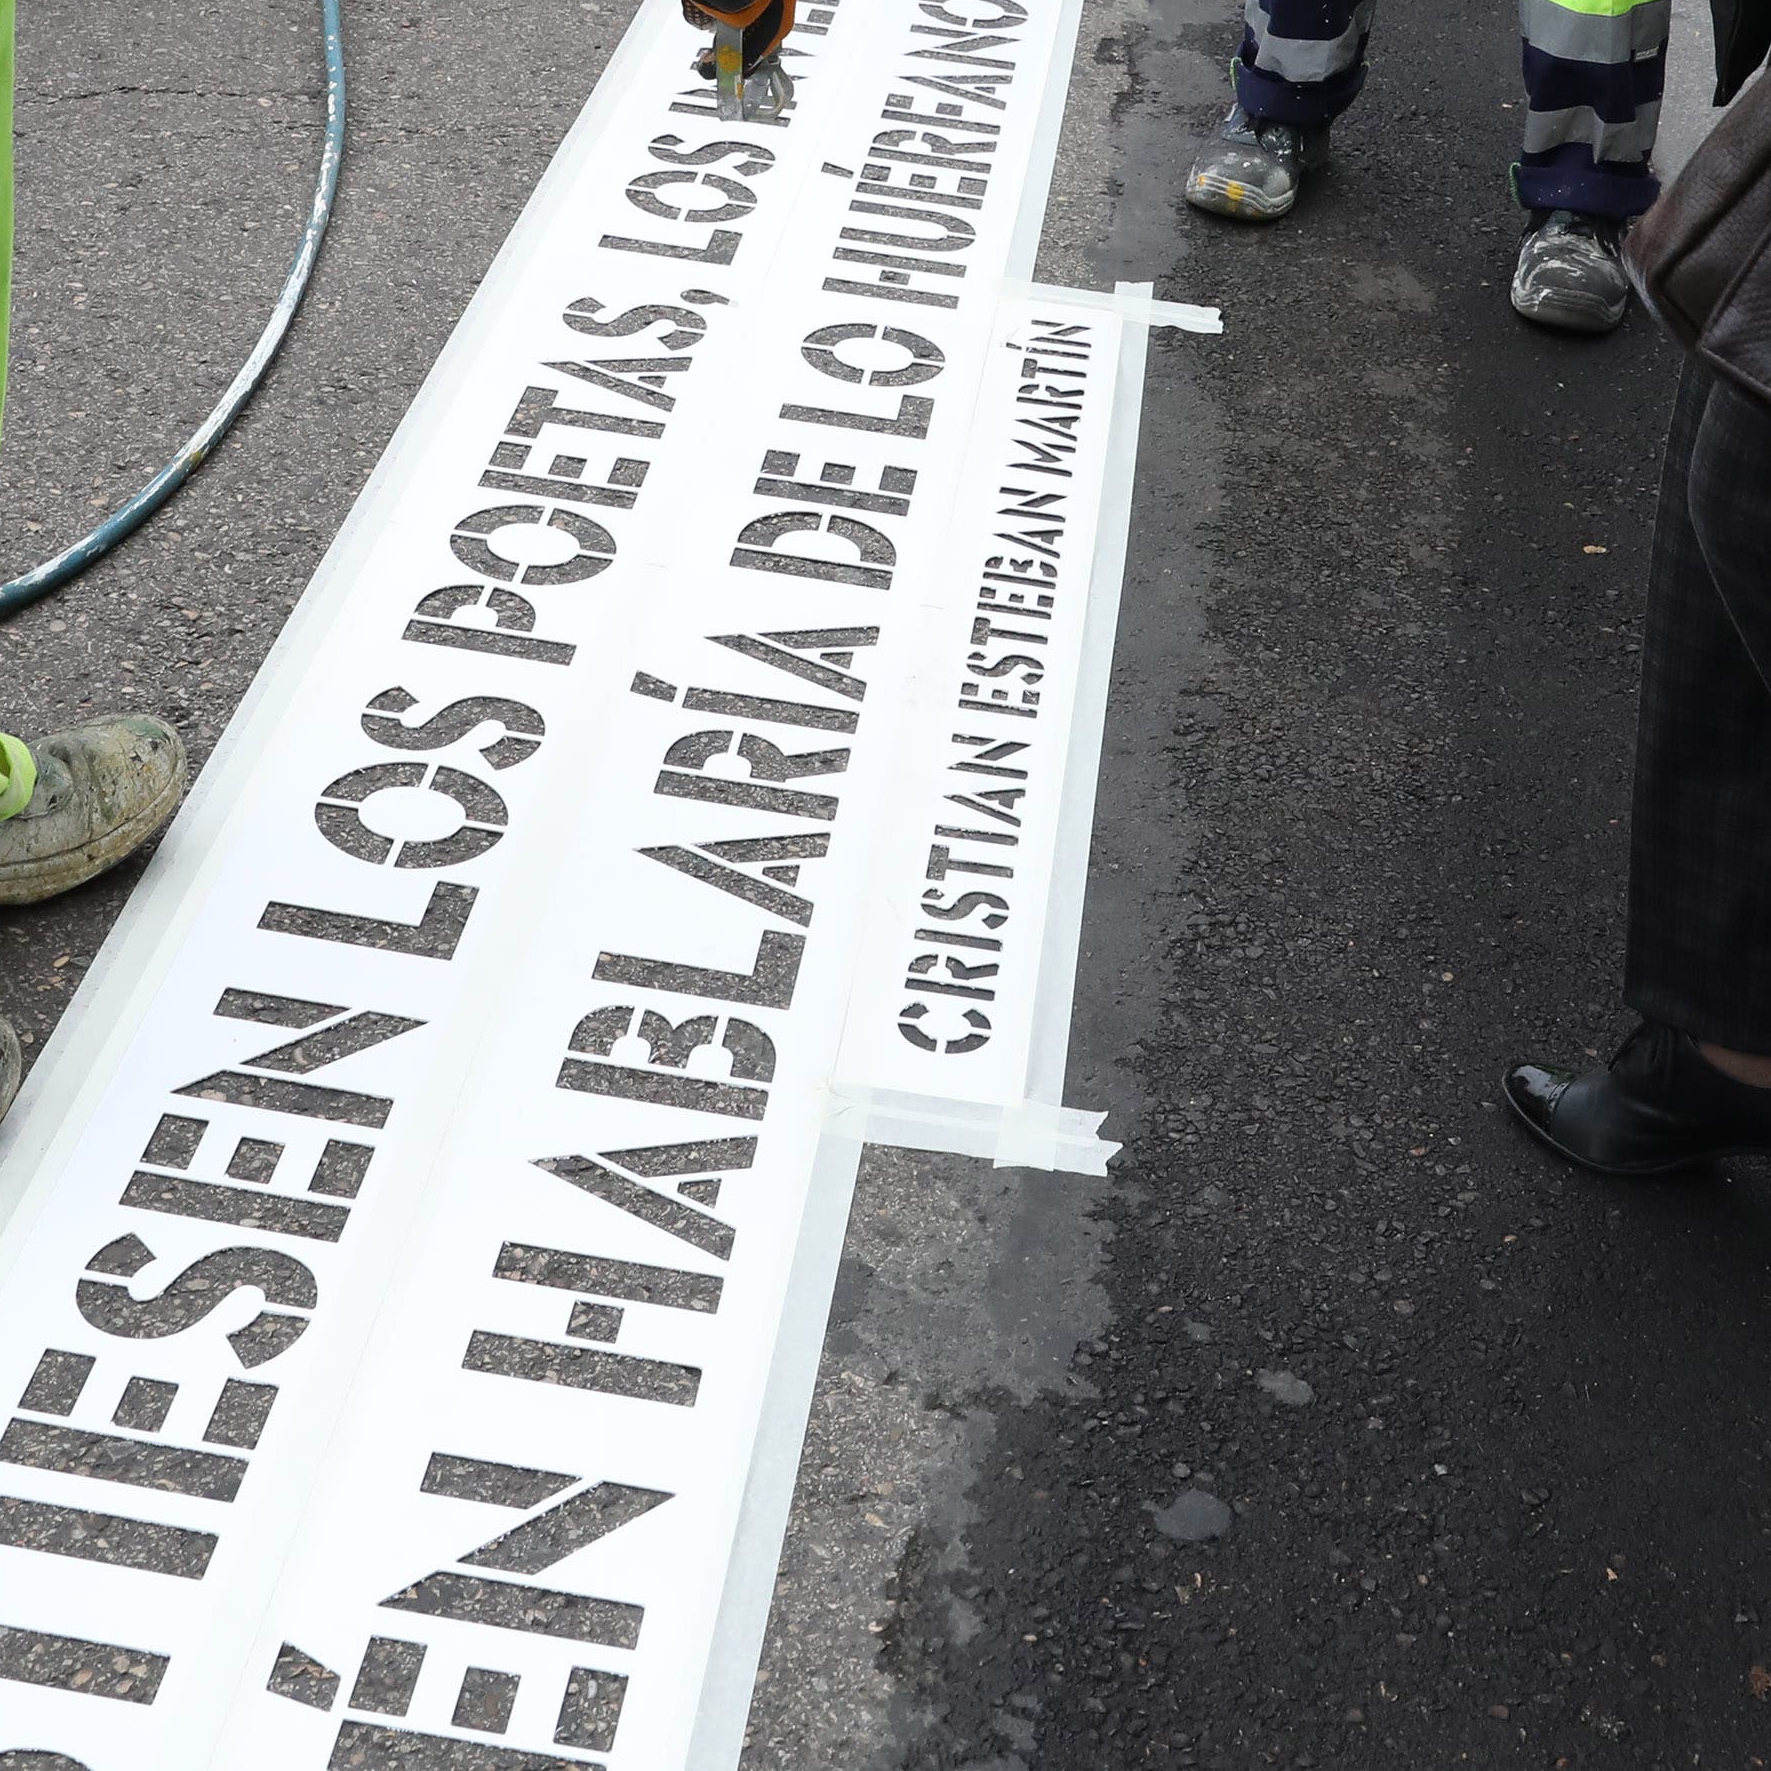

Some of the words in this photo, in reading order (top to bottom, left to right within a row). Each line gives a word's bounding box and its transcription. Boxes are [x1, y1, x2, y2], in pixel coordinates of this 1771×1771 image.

[598, 133, 776, 266] LOS
[401, 288, 739, 666] POETAS,
[778, 321, 946, 440] LO
[1002, 319, 1094, 479] MARTÍN
[728, 449, 918, 591] DE
[958, 487, 1067, 722] ESTEBAN
[257, 684, 547, 960] LOS
[898, 732, 1032, 1055] CRISTIAN
[461, 624, 881, 1408] HABLARÍA
